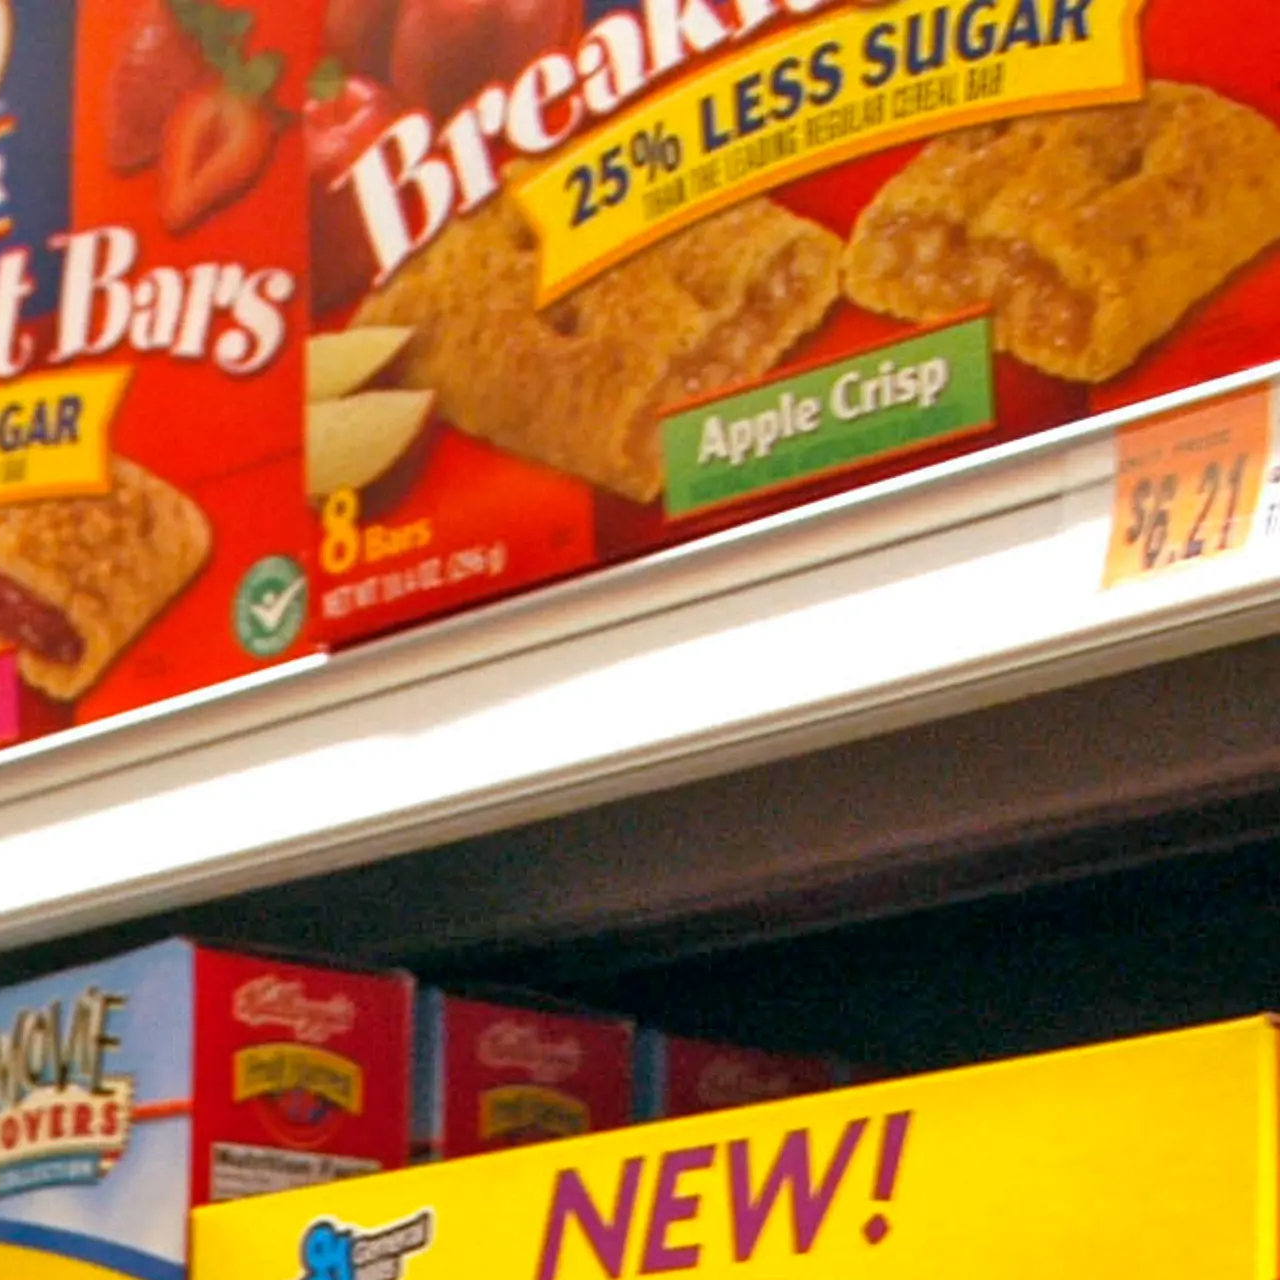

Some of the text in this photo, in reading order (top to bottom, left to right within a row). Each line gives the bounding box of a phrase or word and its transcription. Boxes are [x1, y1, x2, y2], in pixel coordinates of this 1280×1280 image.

[564, 0, 1091, 228] 25% LESS SUGAR
[46, 225, 294, 375] Bars
[697, 390, 822, 468] Apple
[828, 355, 952, 422] Crisp
[320, 487, 359, 575] 8
